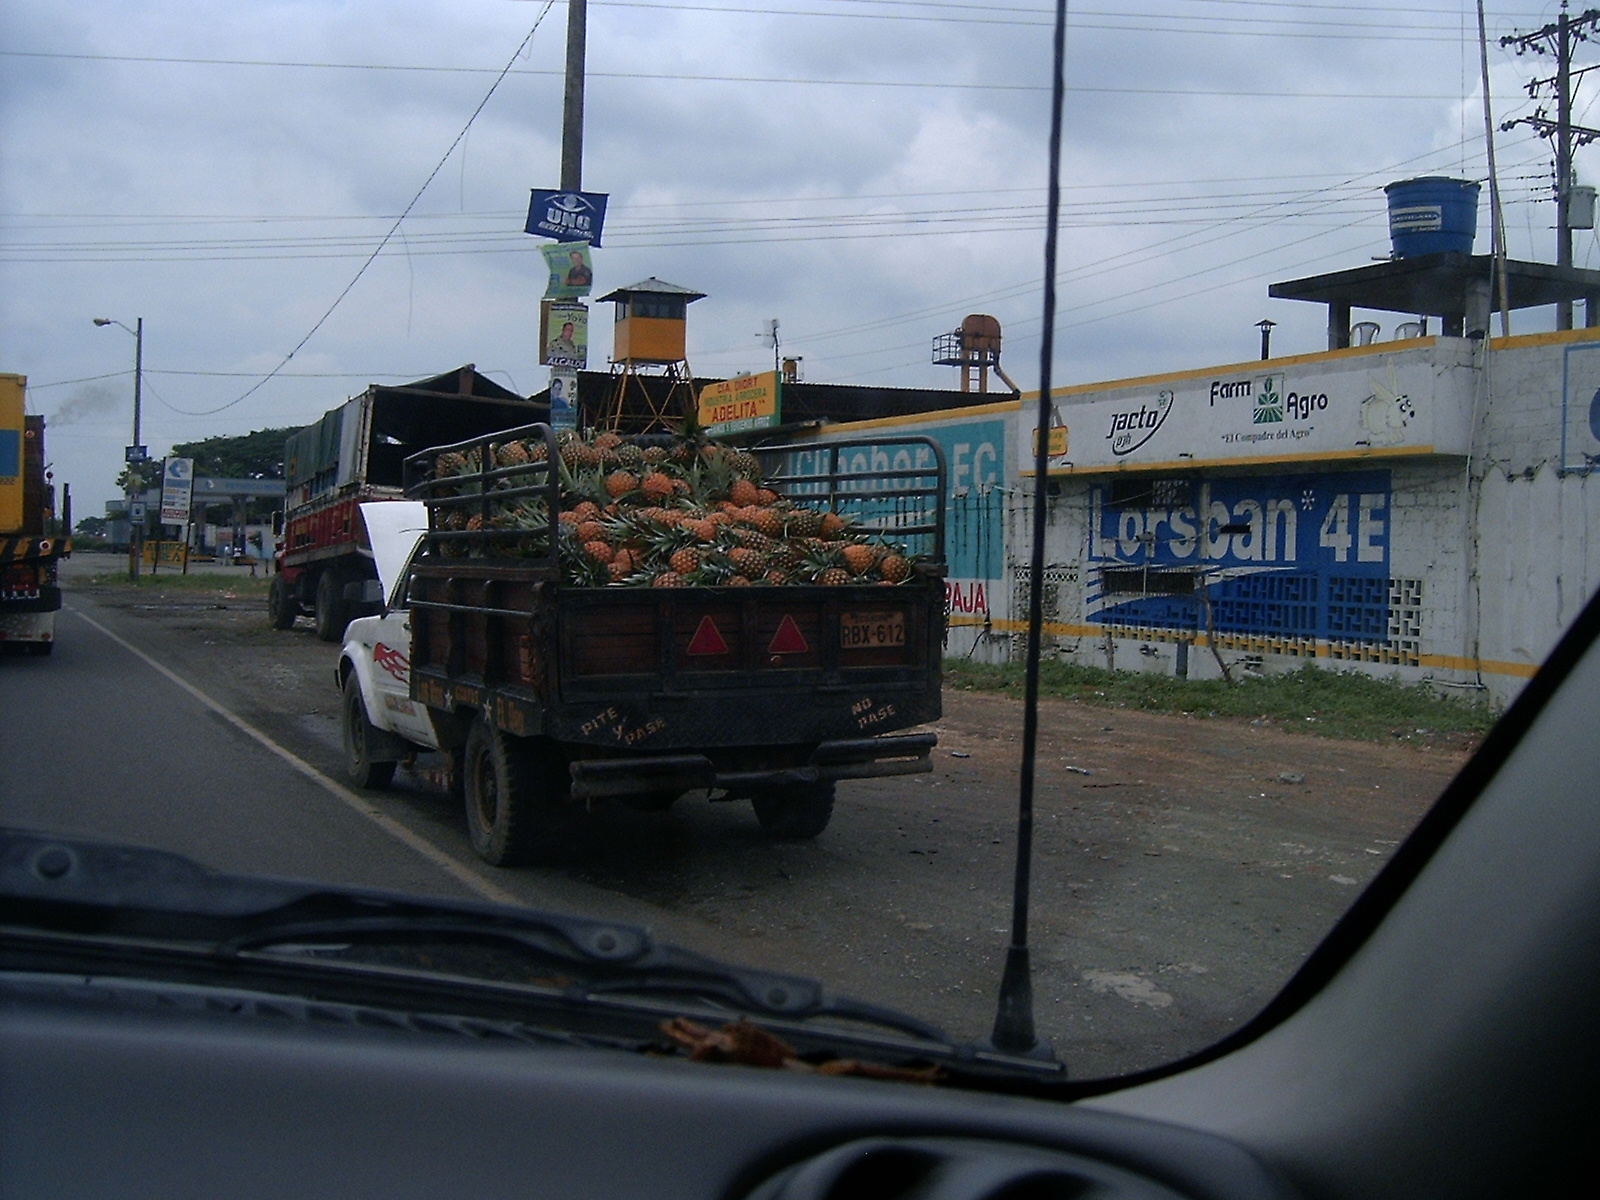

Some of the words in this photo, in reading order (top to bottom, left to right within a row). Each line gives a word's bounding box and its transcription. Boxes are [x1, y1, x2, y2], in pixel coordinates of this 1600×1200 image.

[547, 207, 591, 230] UNO
[1210, 380, 1251, 407] Farm
[1287, 392, 1329, 419] Agro
[952, 442, 996, 499] EC
[1319, 493, 1385, 562] 4E
[842, 624, 904, 646] RBX-612
[581, 707, 618, 736] PITE
